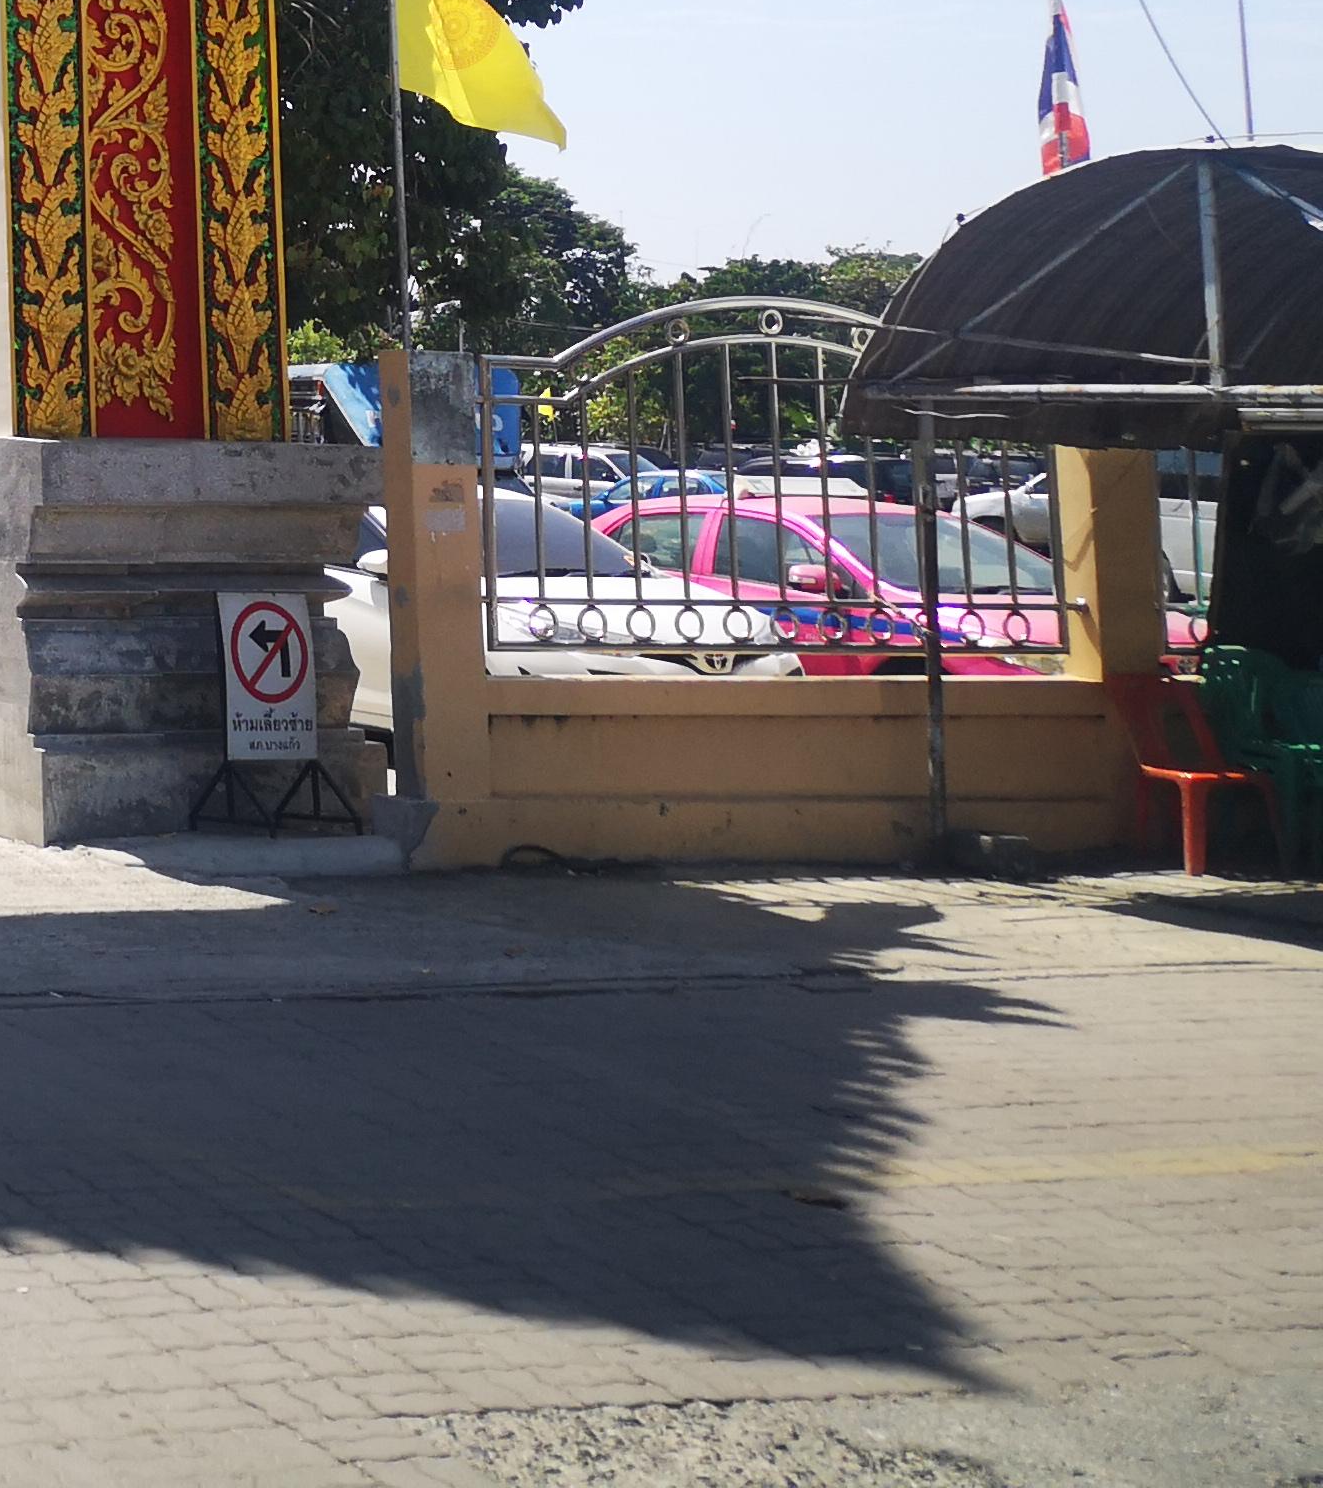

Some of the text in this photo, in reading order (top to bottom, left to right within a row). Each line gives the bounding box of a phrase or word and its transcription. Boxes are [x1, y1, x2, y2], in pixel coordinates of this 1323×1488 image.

[232, 707, 314, 731] ห้ามเลี้ยวซ้าย
